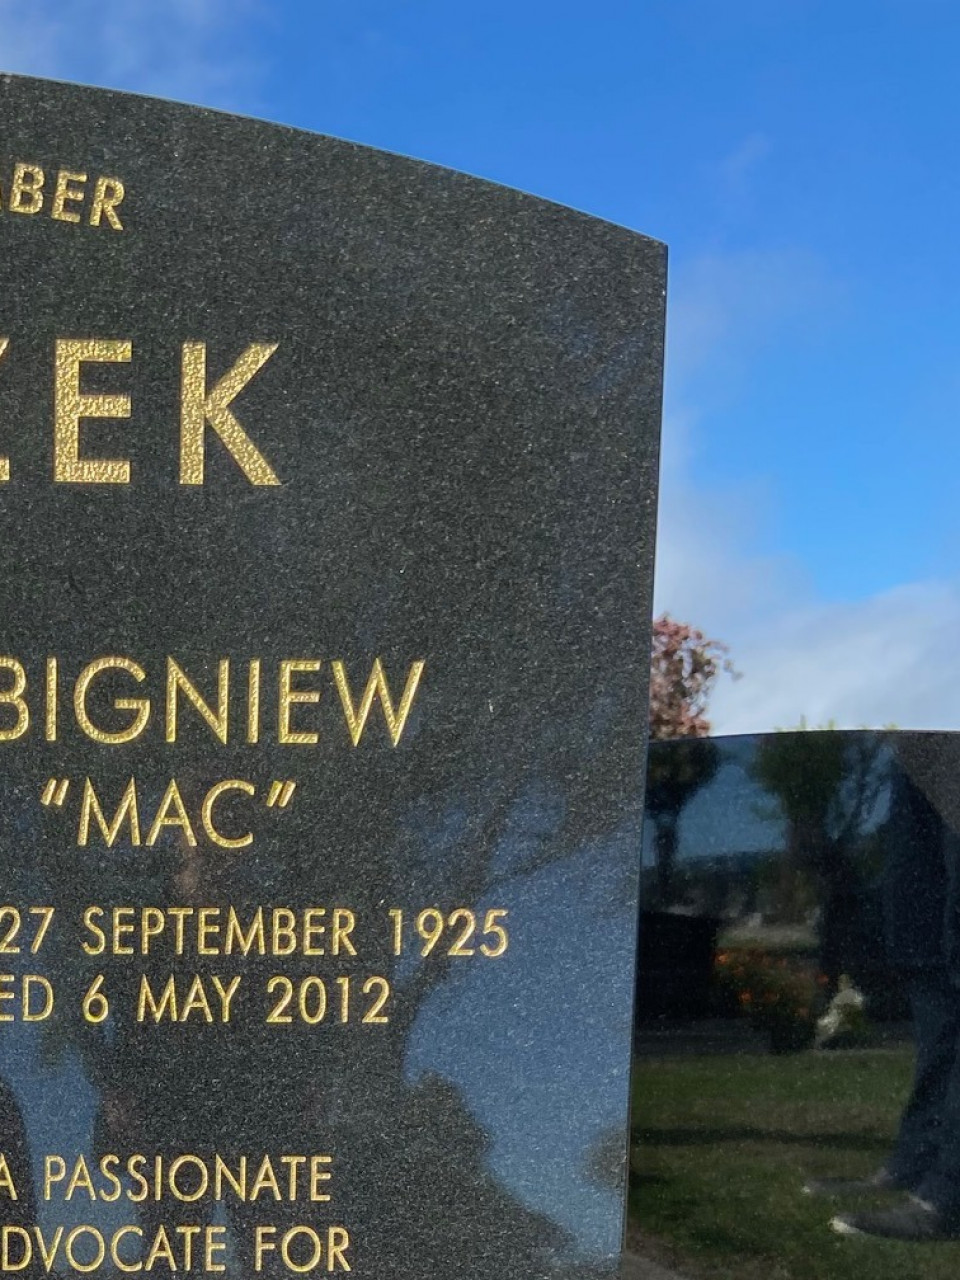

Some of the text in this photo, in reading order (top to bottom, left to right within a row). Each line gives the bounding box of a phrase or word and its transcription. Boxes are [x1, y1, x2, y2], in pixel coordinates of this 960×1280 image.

[83, 906, 357, 955] SEPTEMBER
[389, 908, 507, 956] 1925
[83, 975, 108, 1023] 6
[137, 976, 240, 1022] MAY
[267, 976, 390, 1024] 2012
[45, 1154, 332, 1202] PASSIONATE
[255, 1226, 350, 1272] FOR
